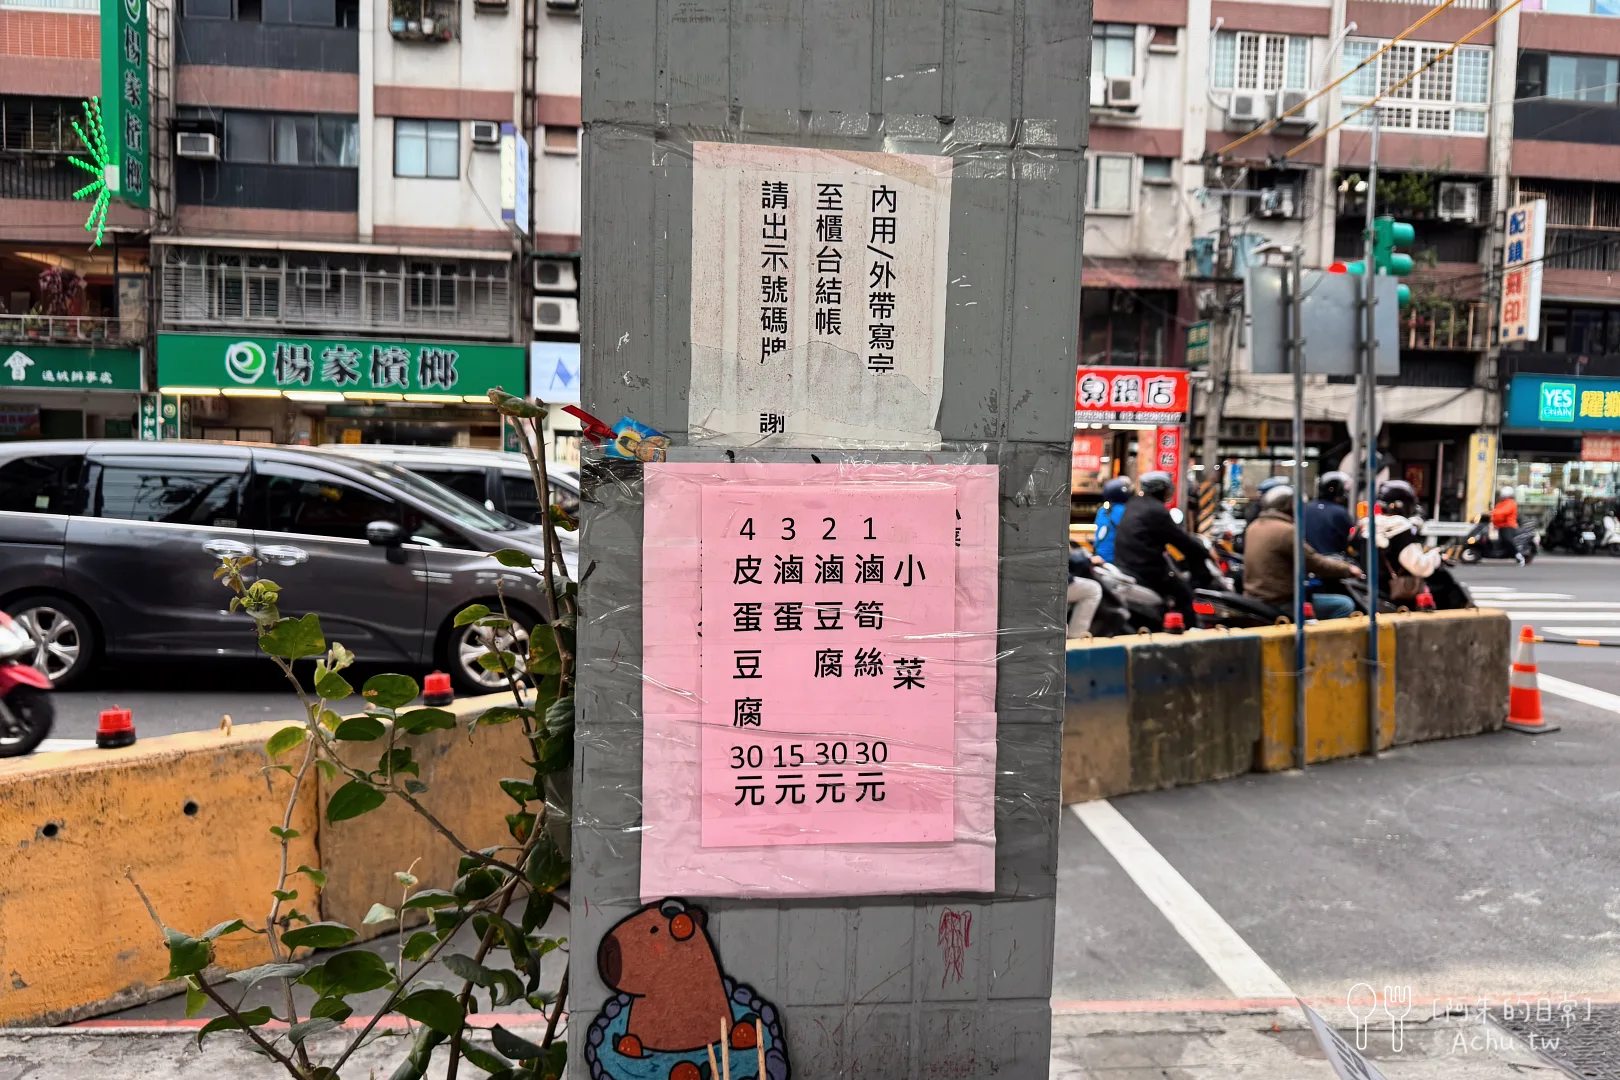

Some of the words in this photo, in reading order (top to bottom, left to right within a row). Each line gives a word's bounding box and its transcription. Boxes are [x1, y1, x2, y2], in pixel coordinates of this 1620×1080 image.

[124, 24, 143, 196] 楊家檳榔
[815, 183, 844, 336] 至櫃台結帳
[272, 342, 459, 390] 楊家檳榔
[1543, 388, 1573, 407] YES
